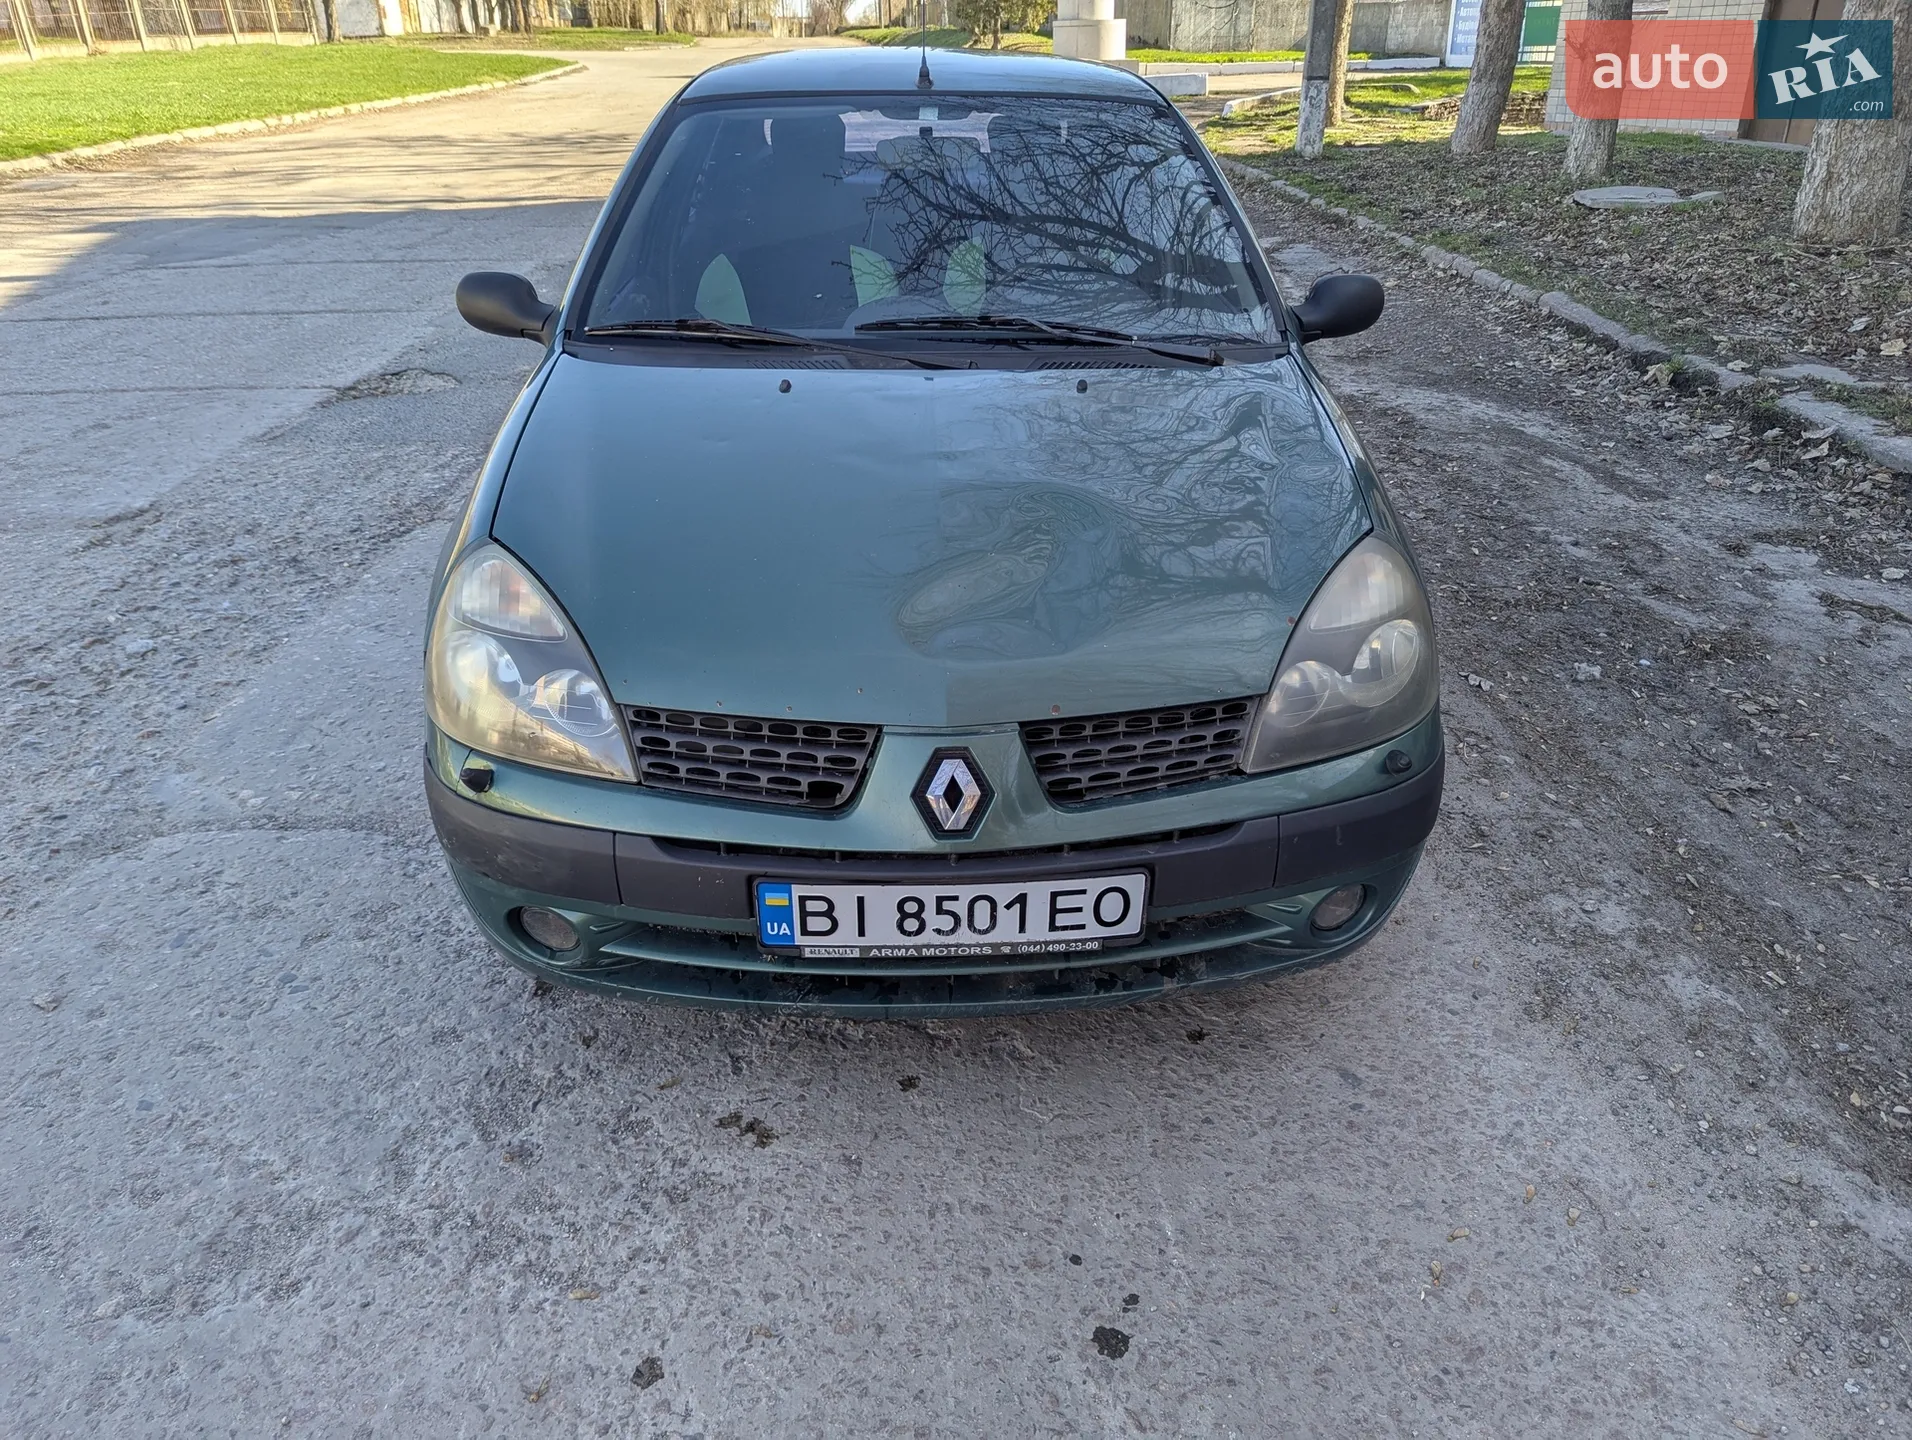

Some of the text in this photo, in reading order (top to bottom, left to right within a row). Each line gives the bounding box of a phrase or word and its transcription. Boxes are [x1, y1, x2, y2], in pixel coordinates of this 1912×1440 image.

[798, 886, 1131, 937] BI 8501 EO
[766, 922, 791, 936] UA
[808, 947, 855, 956] RENAULT
[869, 948, 918, 957] ARMA
[922, 946, 992, 956] MOTORS
